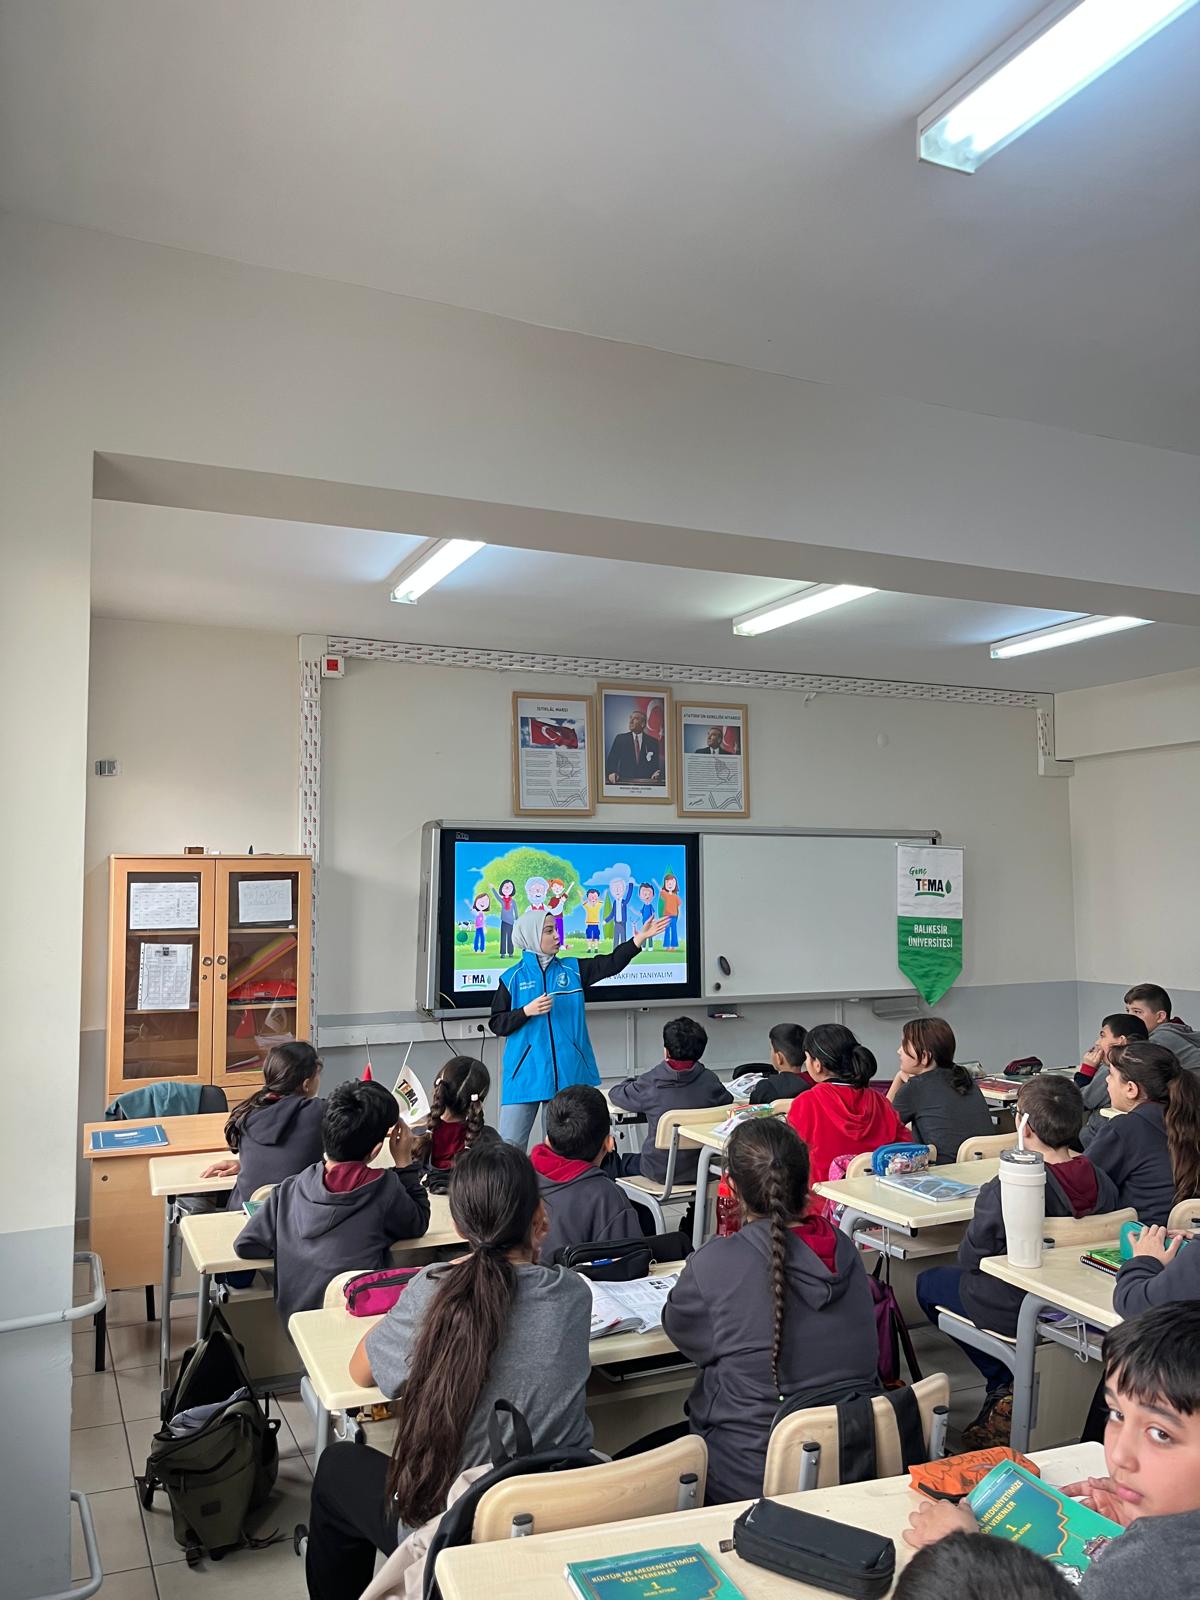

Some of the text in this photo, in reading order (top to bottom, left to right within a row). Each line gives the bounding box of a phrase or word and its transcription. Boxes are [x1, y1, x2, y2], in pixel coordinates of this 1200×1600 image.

[909, 866, 927, 876] Genç
[916, 879, 944, 892] TEMA
[913, 924, 948, 935] BALIKESİR
[908, 935, 953, 948] ÜNİVERSİTESİ
[462, 974, 485, 984] TEMA
[640, 971, 673, 979] TANIYALIM
[398, 1079, 419, 1107] TEMA
[1006, 1524, 1017, 1532] 1
[651, 1581, 661, 1590] 1
